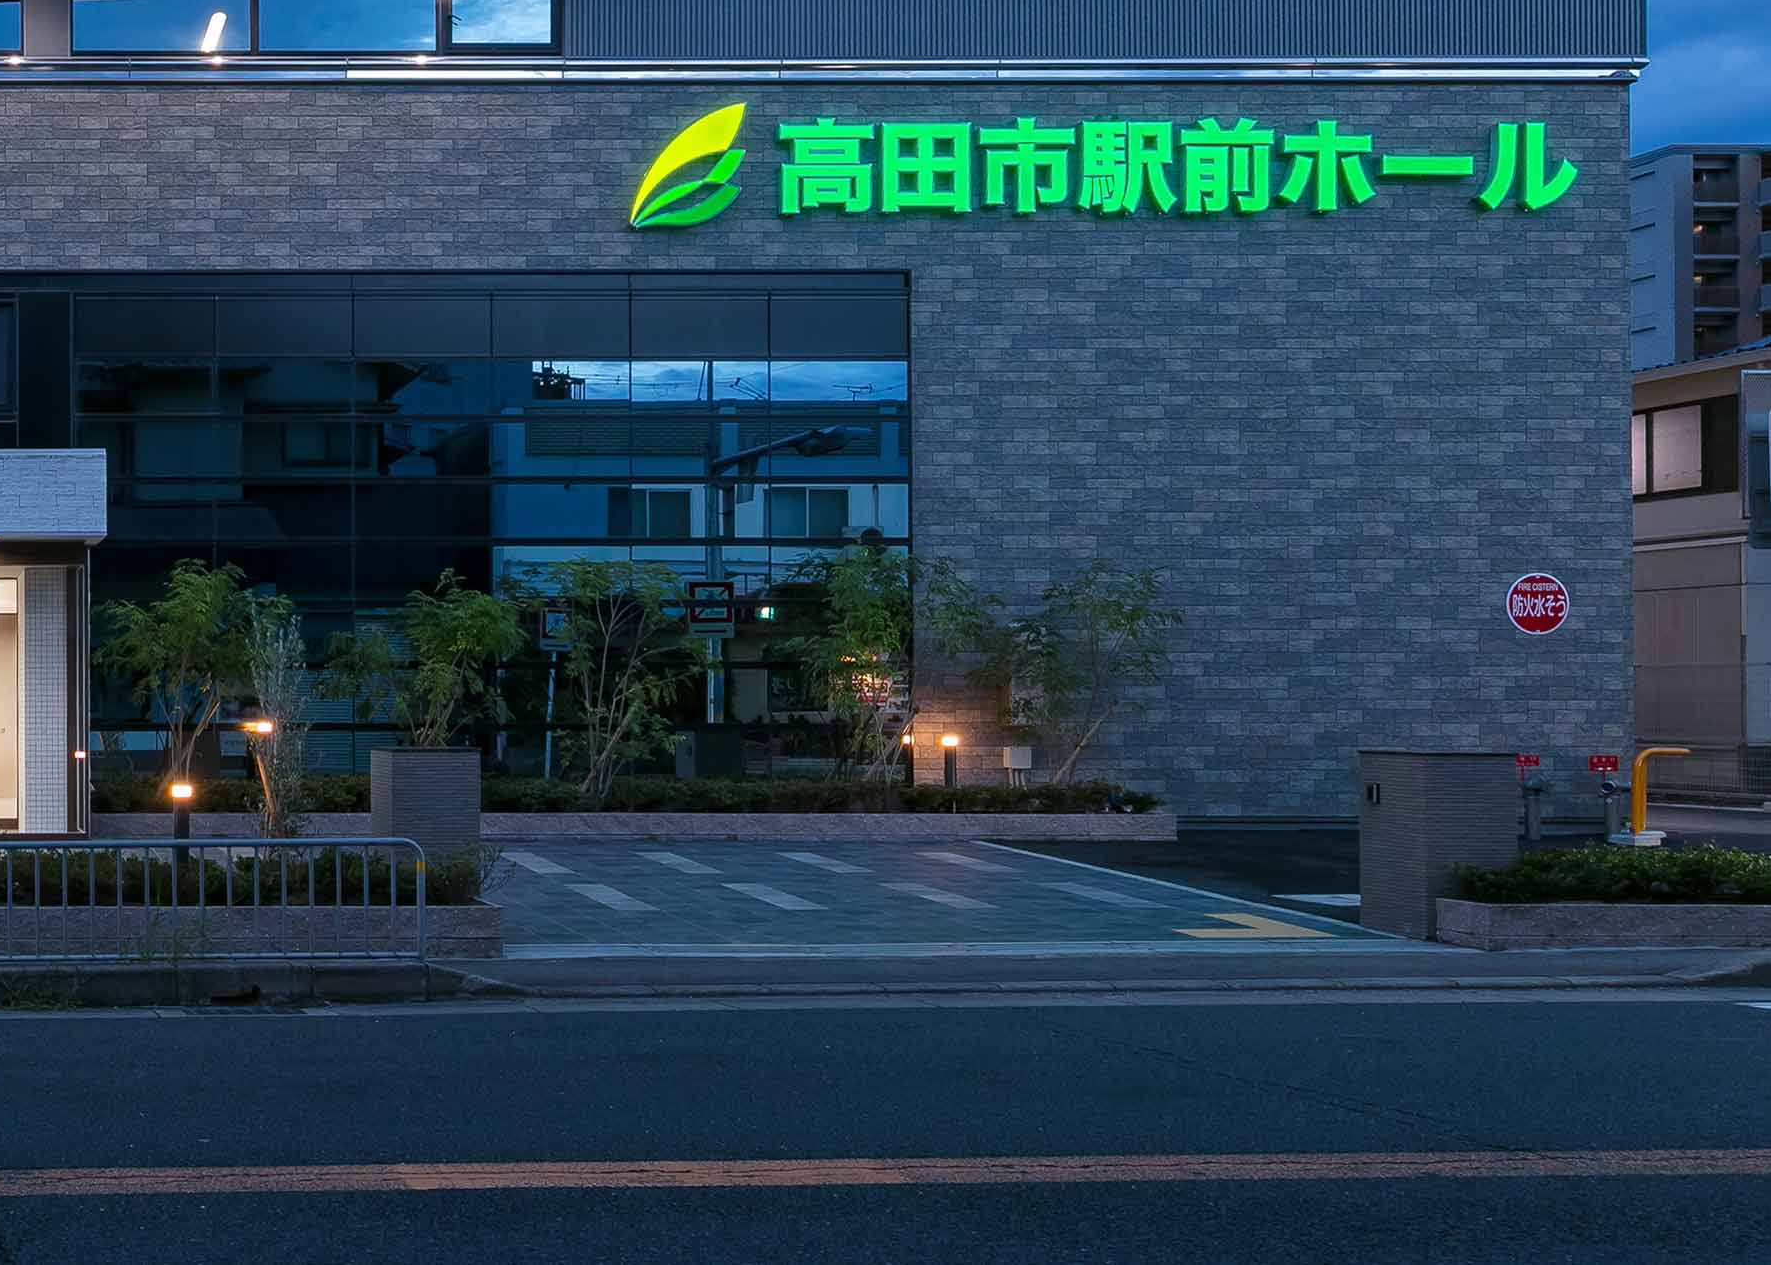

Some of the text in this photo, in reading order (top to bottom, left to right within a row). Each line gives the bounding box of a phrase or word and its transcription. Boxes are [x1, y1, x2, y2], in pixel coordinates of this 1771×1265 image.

[778, 118, 1577, 214] 高田市駅前ホール
[1517, 582, 1532, 591] FIRE
[1512, 594, 1566, 617] 防火水そう
